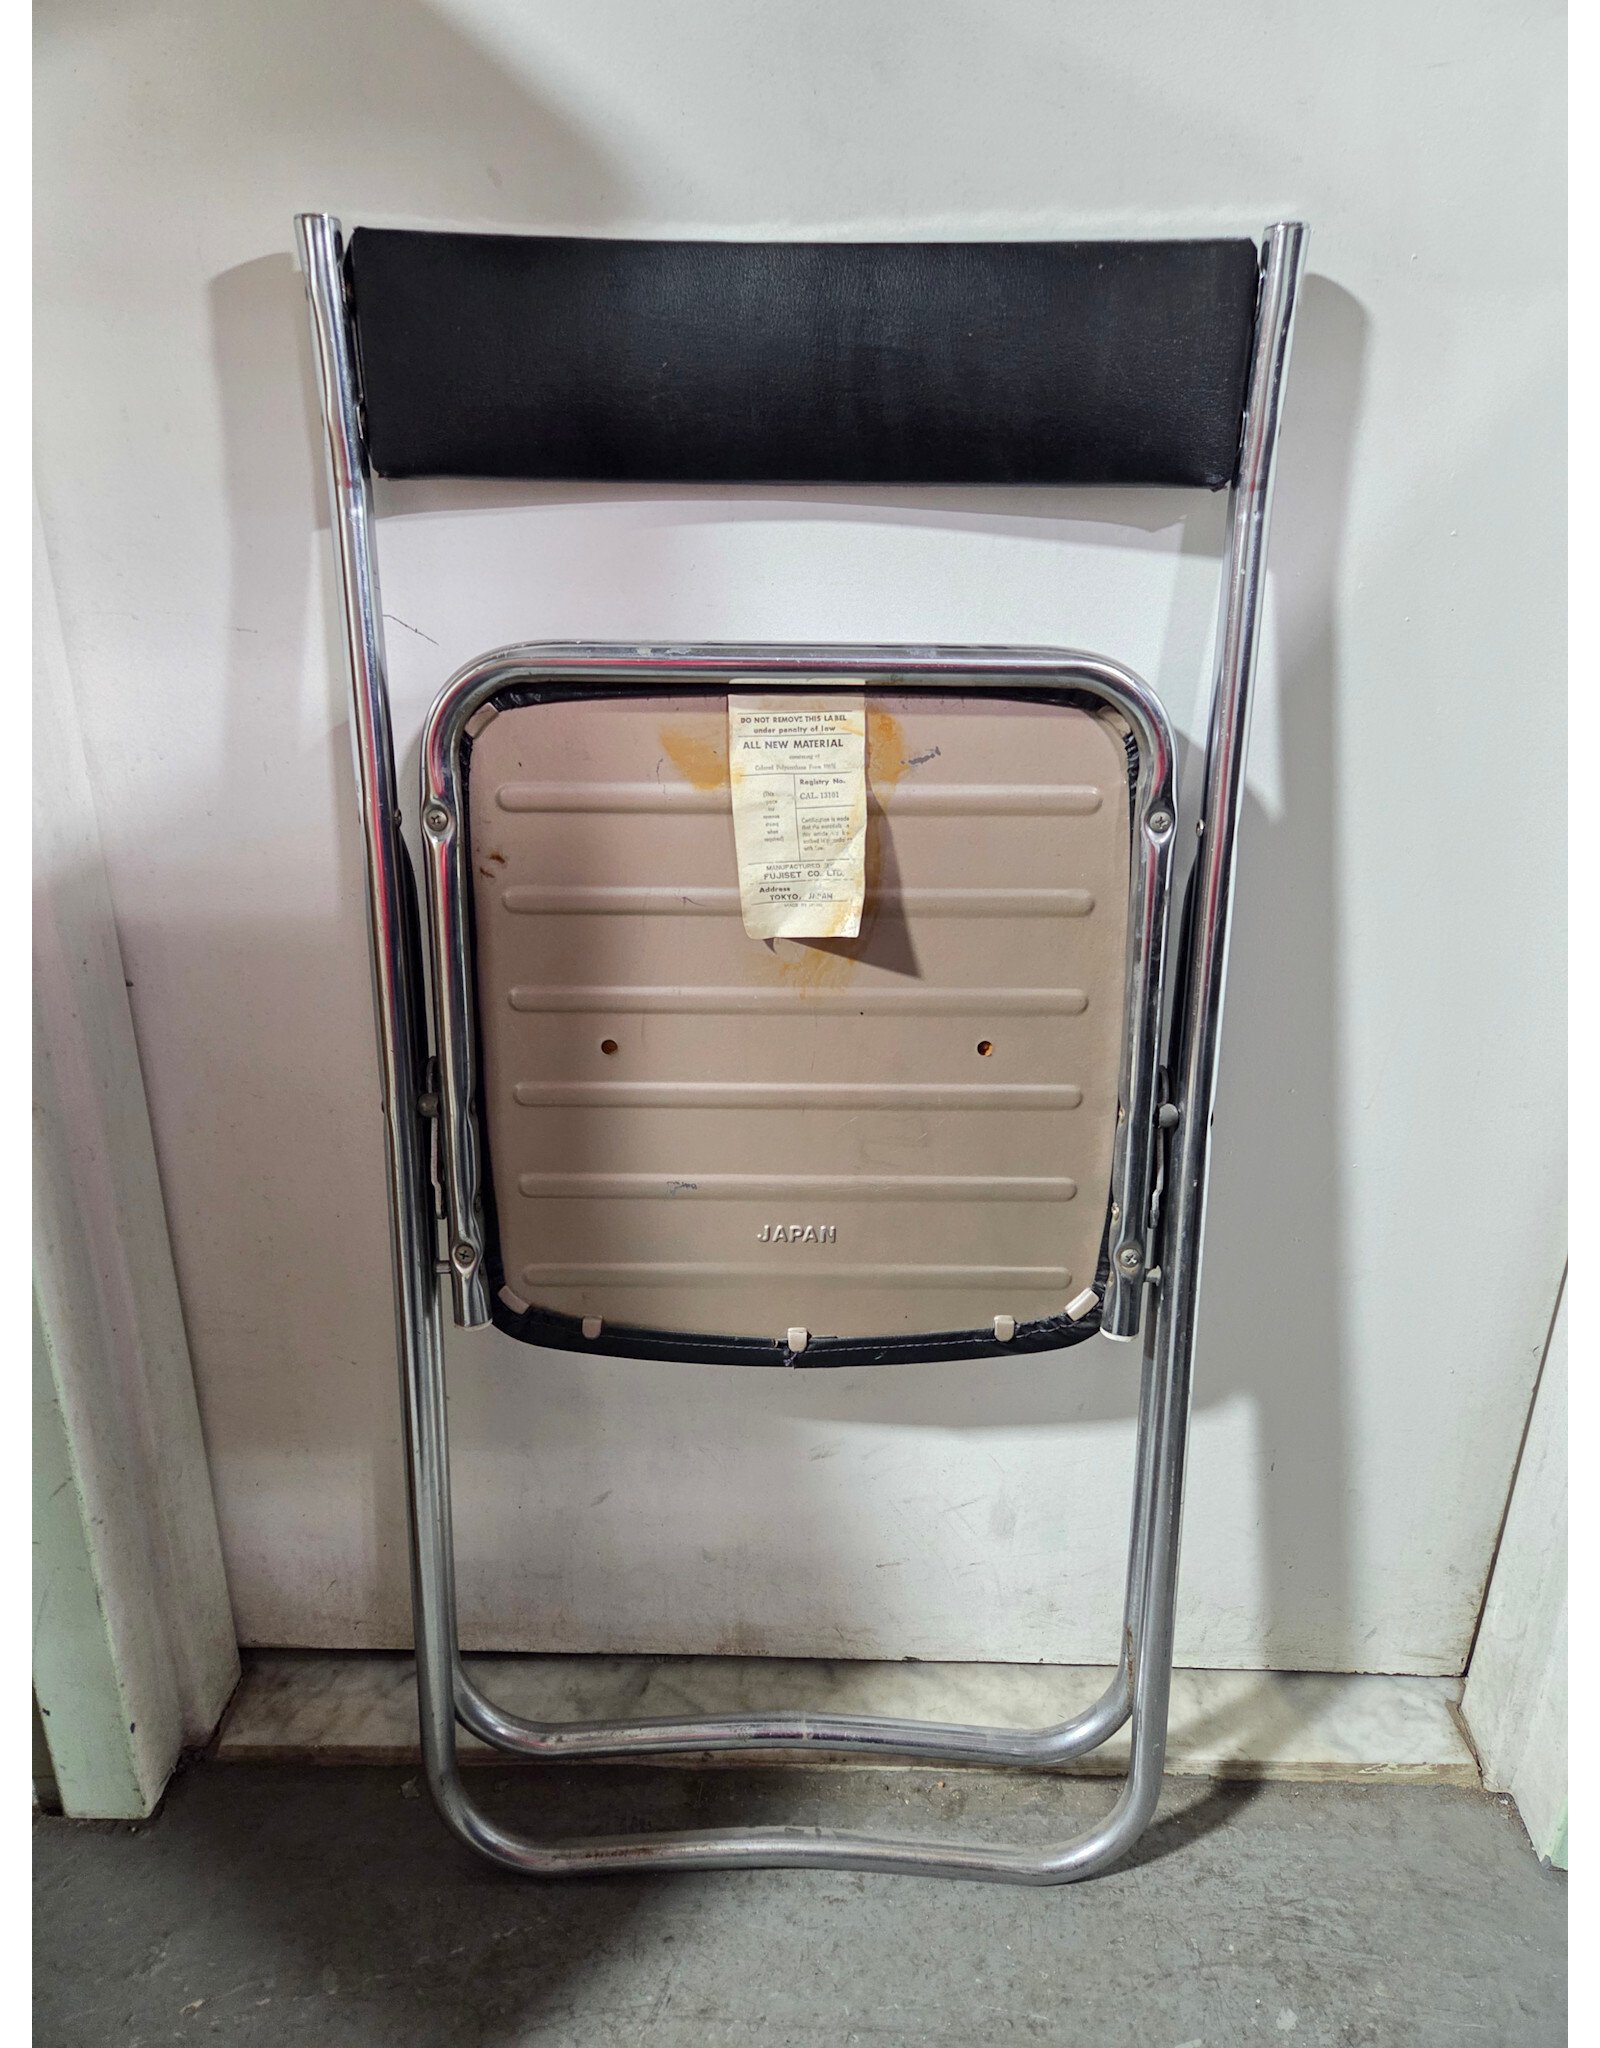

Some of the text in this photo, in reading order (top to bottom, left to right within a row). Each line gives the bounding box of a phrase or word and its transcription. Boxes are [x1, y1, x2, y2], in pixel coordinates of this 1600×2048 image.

[754, 716, 770, 724] NOT
[824, 714, 847, 722] LABEL
[754, 726, 776, 734] under
[778, 725, 808, 735] penalty
[743, 739, 844, 750] ALL NEW MATERIAL
[800, 792, 818, 800] CAL.
[766, 863, 821, 871] MANUFACTURED
[763, 871, 802, 880] FUJISET
[769, 893, 802, 901] TOKYO,
[756, 1224, 837, 1243] JAPAN
